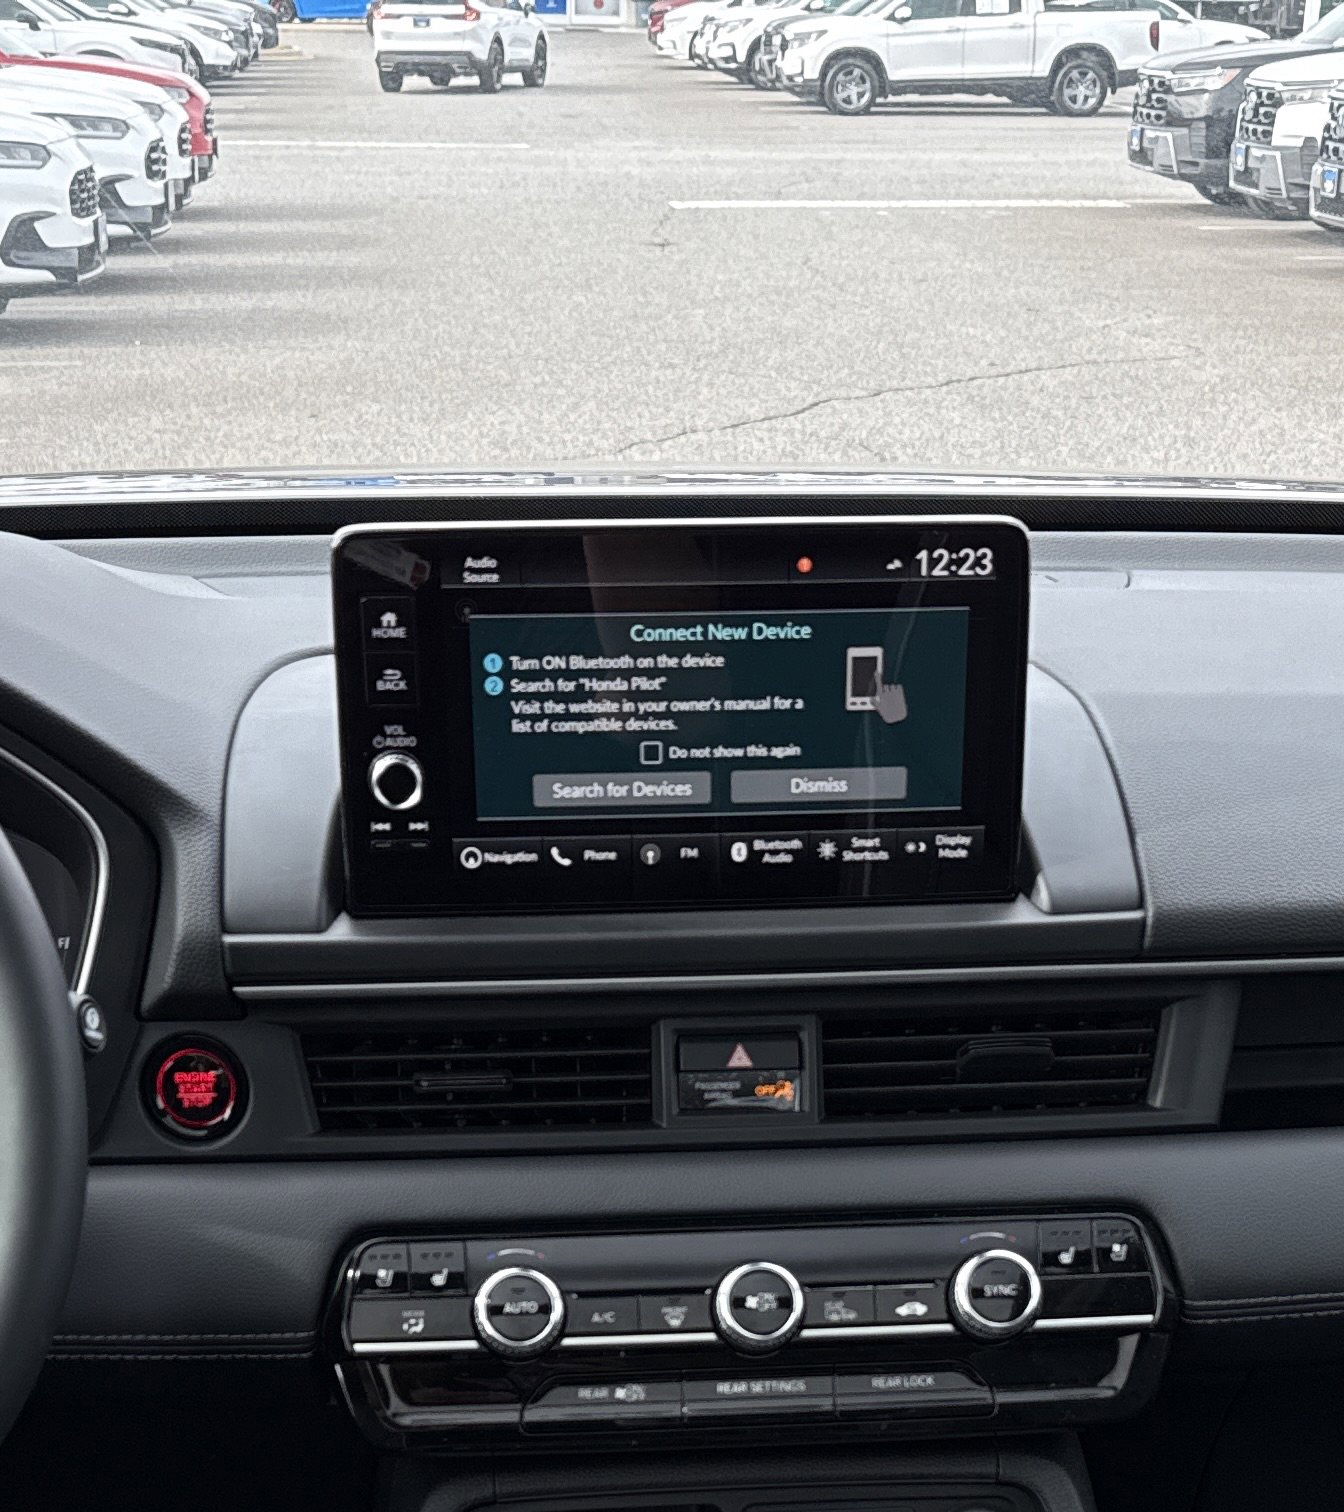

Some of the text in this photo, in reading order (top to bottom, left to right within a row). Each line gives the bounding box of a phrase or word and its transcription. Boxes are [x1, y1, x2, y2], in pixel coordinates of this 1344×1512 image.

[464, 556, 498, 570] Audio
[915, 547, 994, 577] 12:23
[462, 571, 500, 584] Source
[371, 628, 407, 639] HOME
[629, 621, 812, 642] Connect New Device
[509, 655, 540, 671] Turn
[542, 655, 566, 670] ON
[569, 654, 634, 669] Bluetooth
[635, 657, 655, 669] on
[656, 654, 678, 668] the
[681, 653, 725, 668] device
[375, 680, 408, 691] BACK
[509, 678, 555, 693] Search
[556, 677, 577, 692] for
[578, 677, 629, 692] "Honda
[630, 676, 667, 691] Pilot"
[510, 695, 805, 716] Visit the website in your owner's manual for a
[383, 724, 406, 735] VOL
[511, 716, 678, 734] list of compatible devices.
[385, 736, 418, 748] AUDIO
[668, 742, 802, 760] Do not show this again
[552, 780, 693, 800] Search for Devices
[790, 776, 849, 795] Dismiss
[752, 837, 803, 851] Bluetooth
[850, 836, 881, 849] Smart
[934, 834, 972, 848] Display
[483, 850, 539, 865] Navigation
[583, 848, 618, 862] Phone
[680, 847, 699, 860] FM
[761, 851, 794, 864] Audio
[841, 848, 890, 862] Shortcuts
[937, 847, 969, 860] Mode
[983, 1283, 1019, 1298] SYNC
[502, 1300, 540, 1315] AUTO
[590, 1310, 616, 1324] A/C
[716, 1379, 807, 1395] REAR SETTINGS
[872, 1374, 936, 1389] REAR LOCK
[577, 1387, 610, 1400] REAR
